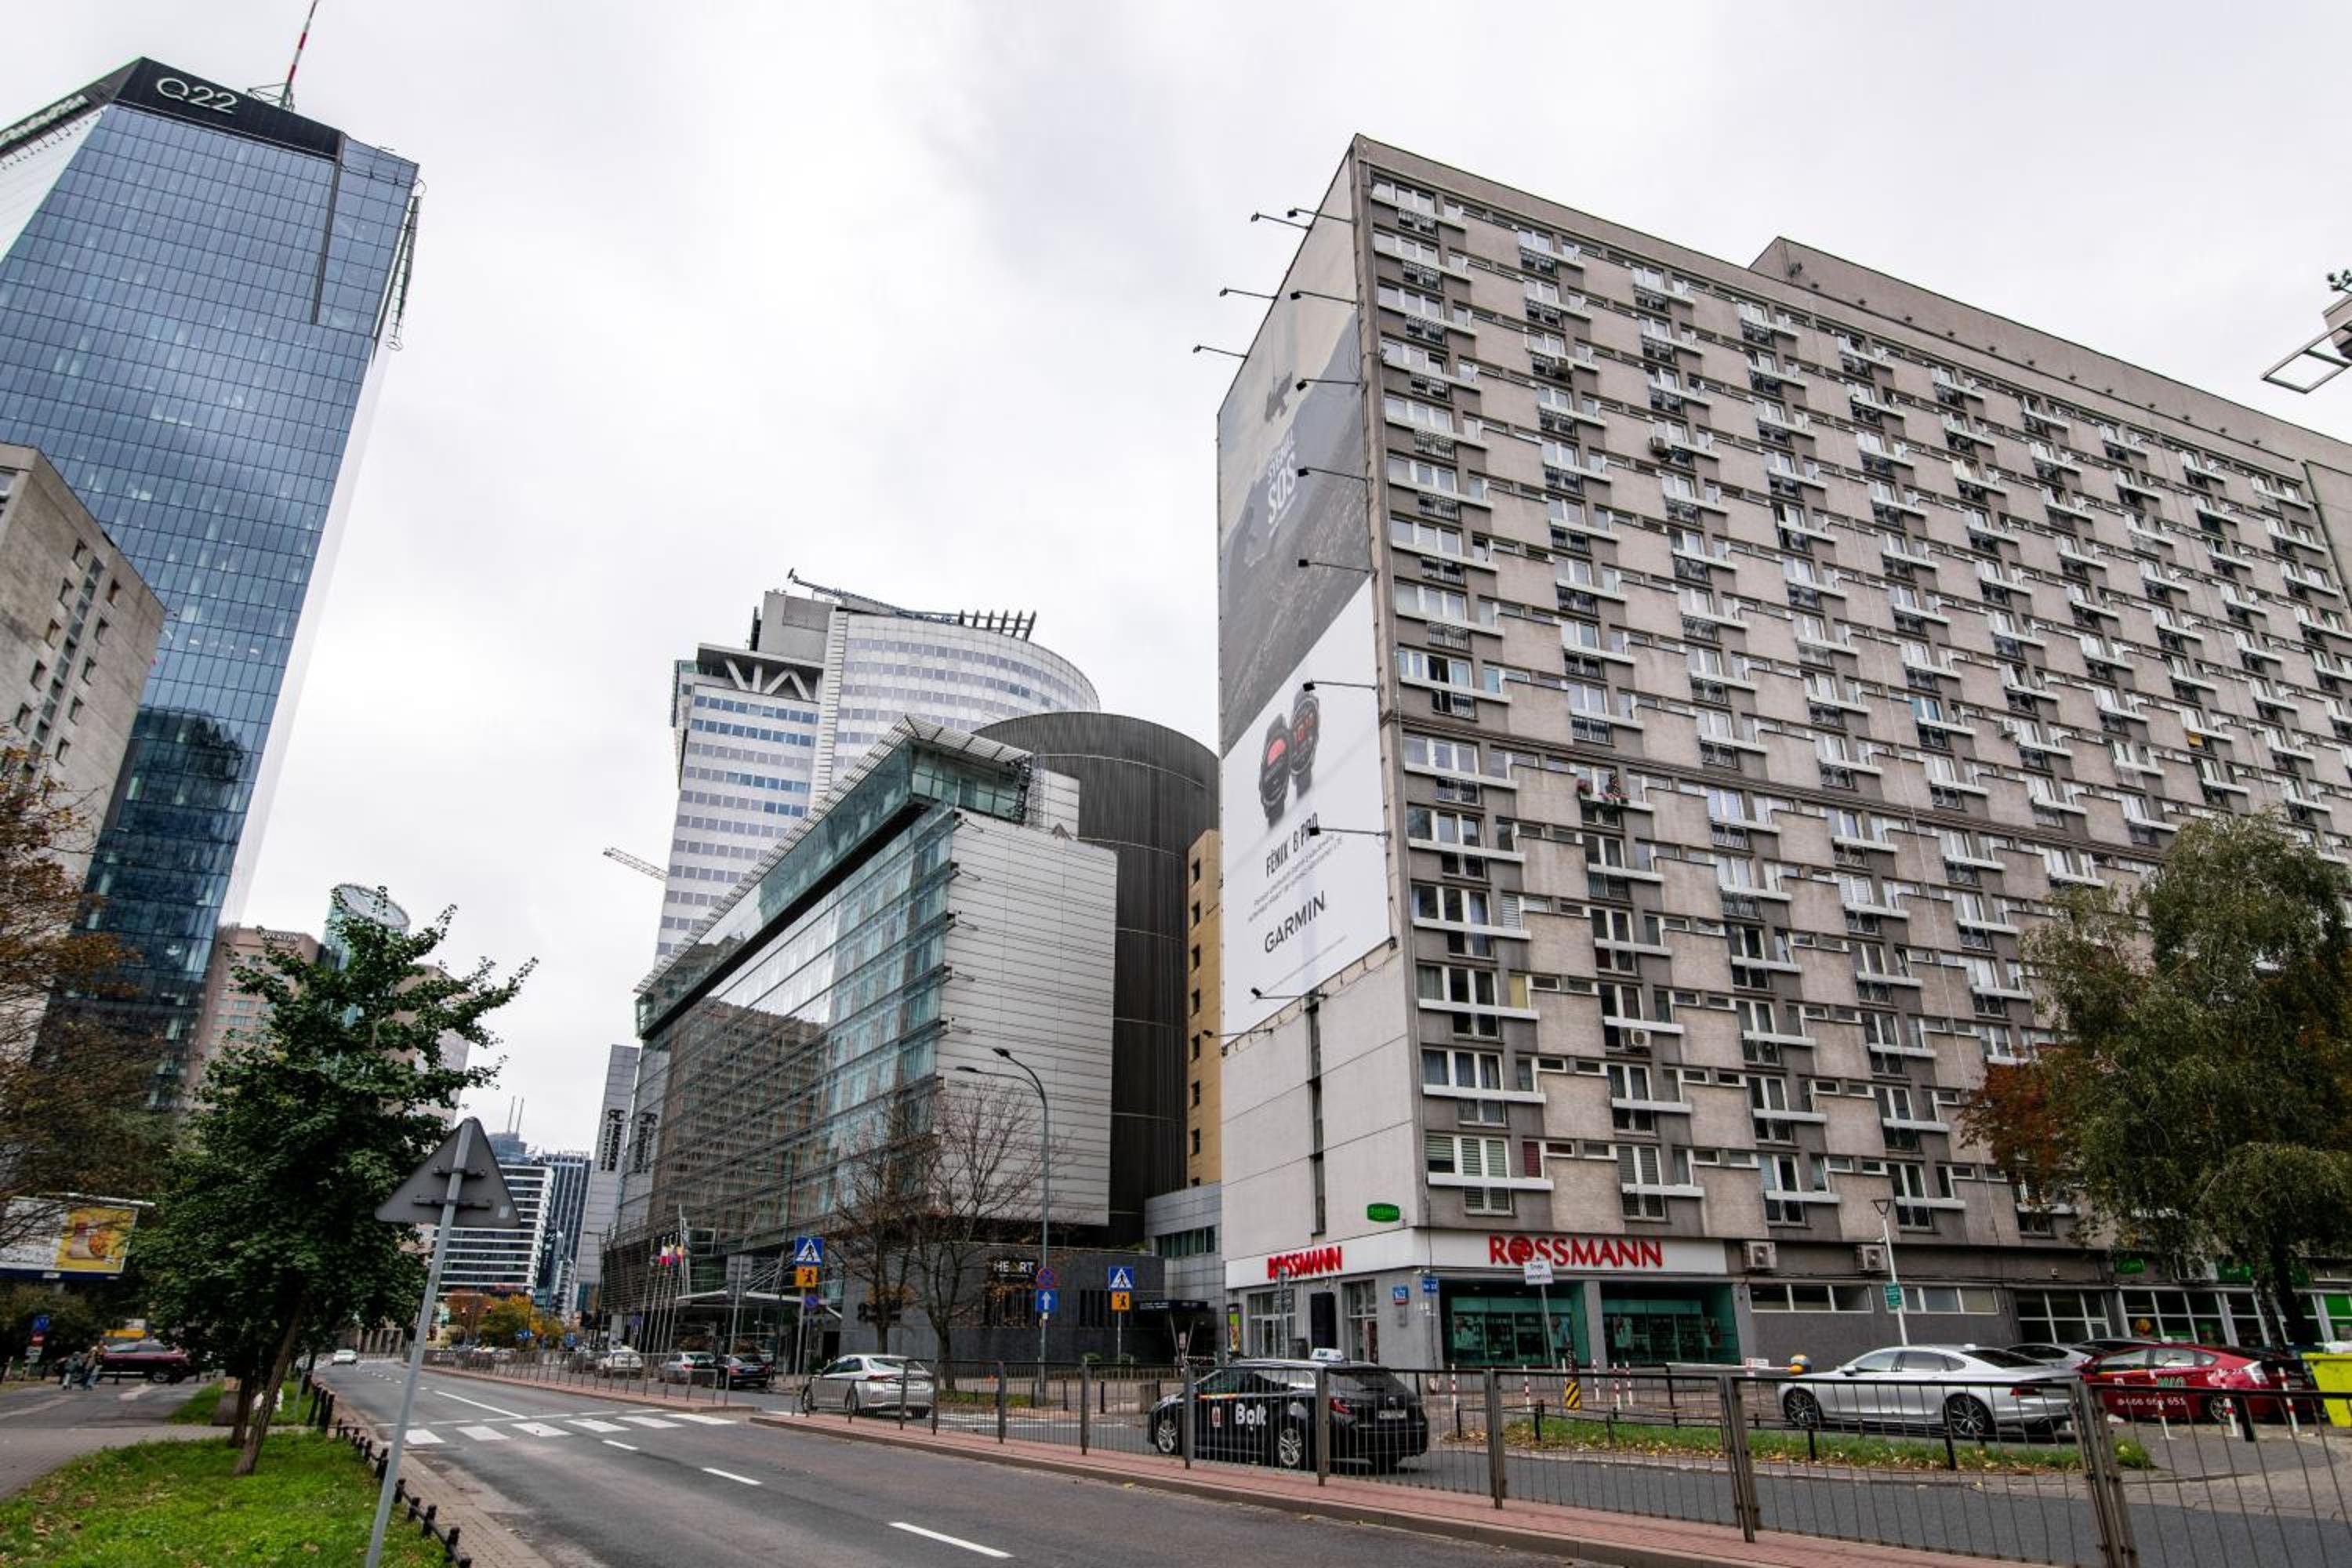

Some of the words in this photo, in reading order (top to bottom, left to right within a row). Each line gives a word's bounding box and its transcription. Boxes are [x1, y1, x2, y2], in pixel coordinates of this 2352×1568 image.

[157, 78, 238, 114] Q22
[1267, 452, 1297, 525] SOS
[1265, 890, 1324, 953] GARMIN
[1489, 1233, 1663, 1268] ROSSMANN
[1235, 1403, 1267, 1428] Bolt
